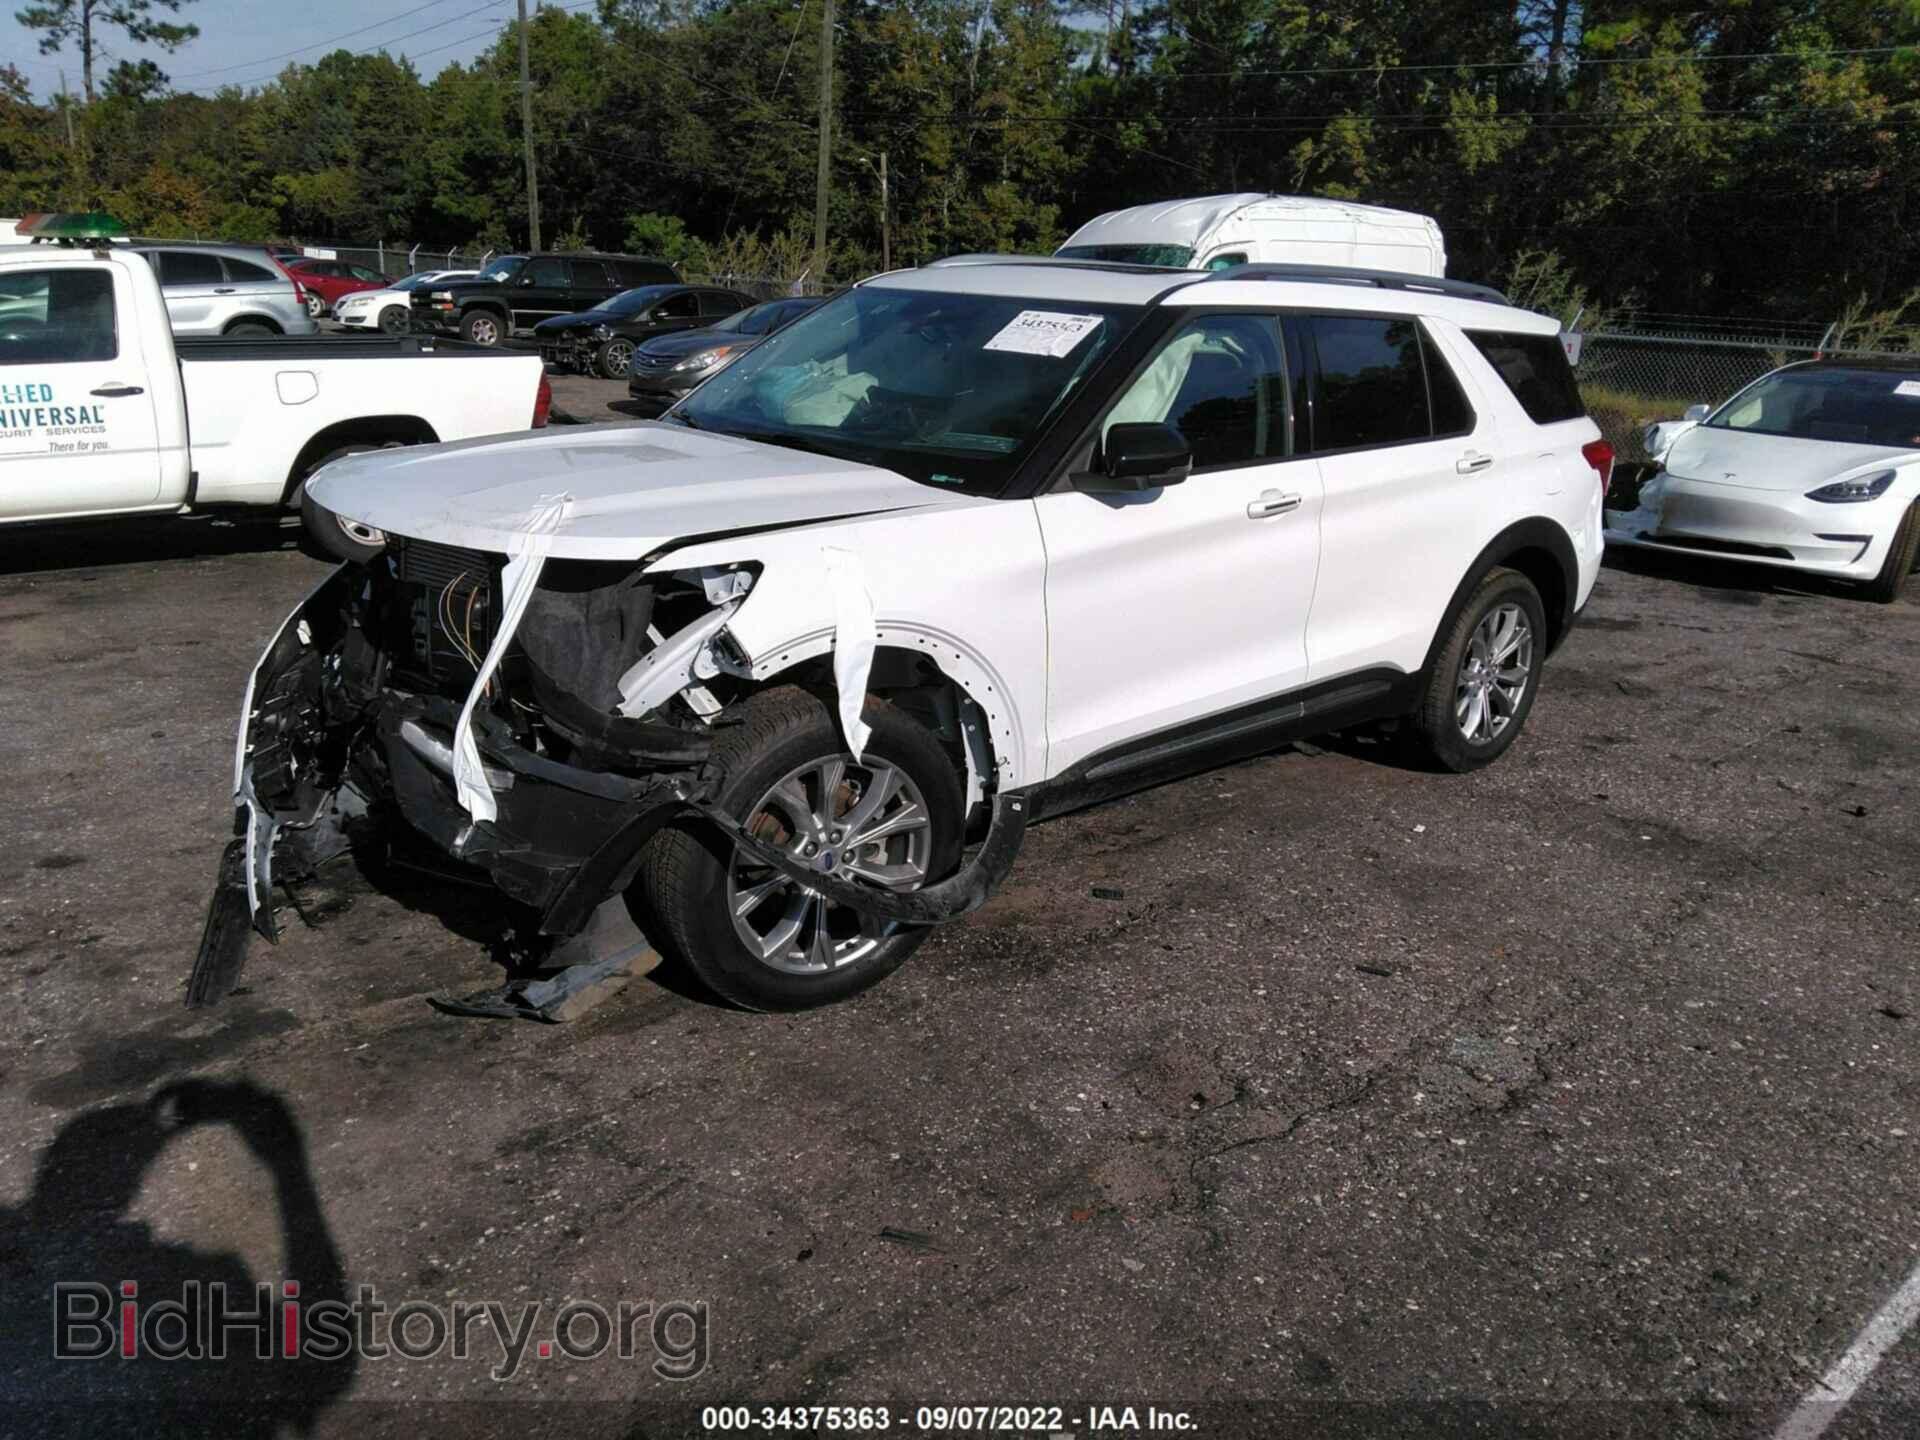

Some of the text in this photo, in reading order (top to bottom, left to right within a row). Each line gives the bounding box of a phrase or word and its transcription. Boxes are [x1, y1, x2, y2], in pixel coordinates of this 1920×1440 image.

[0, 384, 53, 404] LIED
[46, 426, 106, 436] SERVICES
[49, 441, 75, 452] There
[77, 440, 89, 450] for
